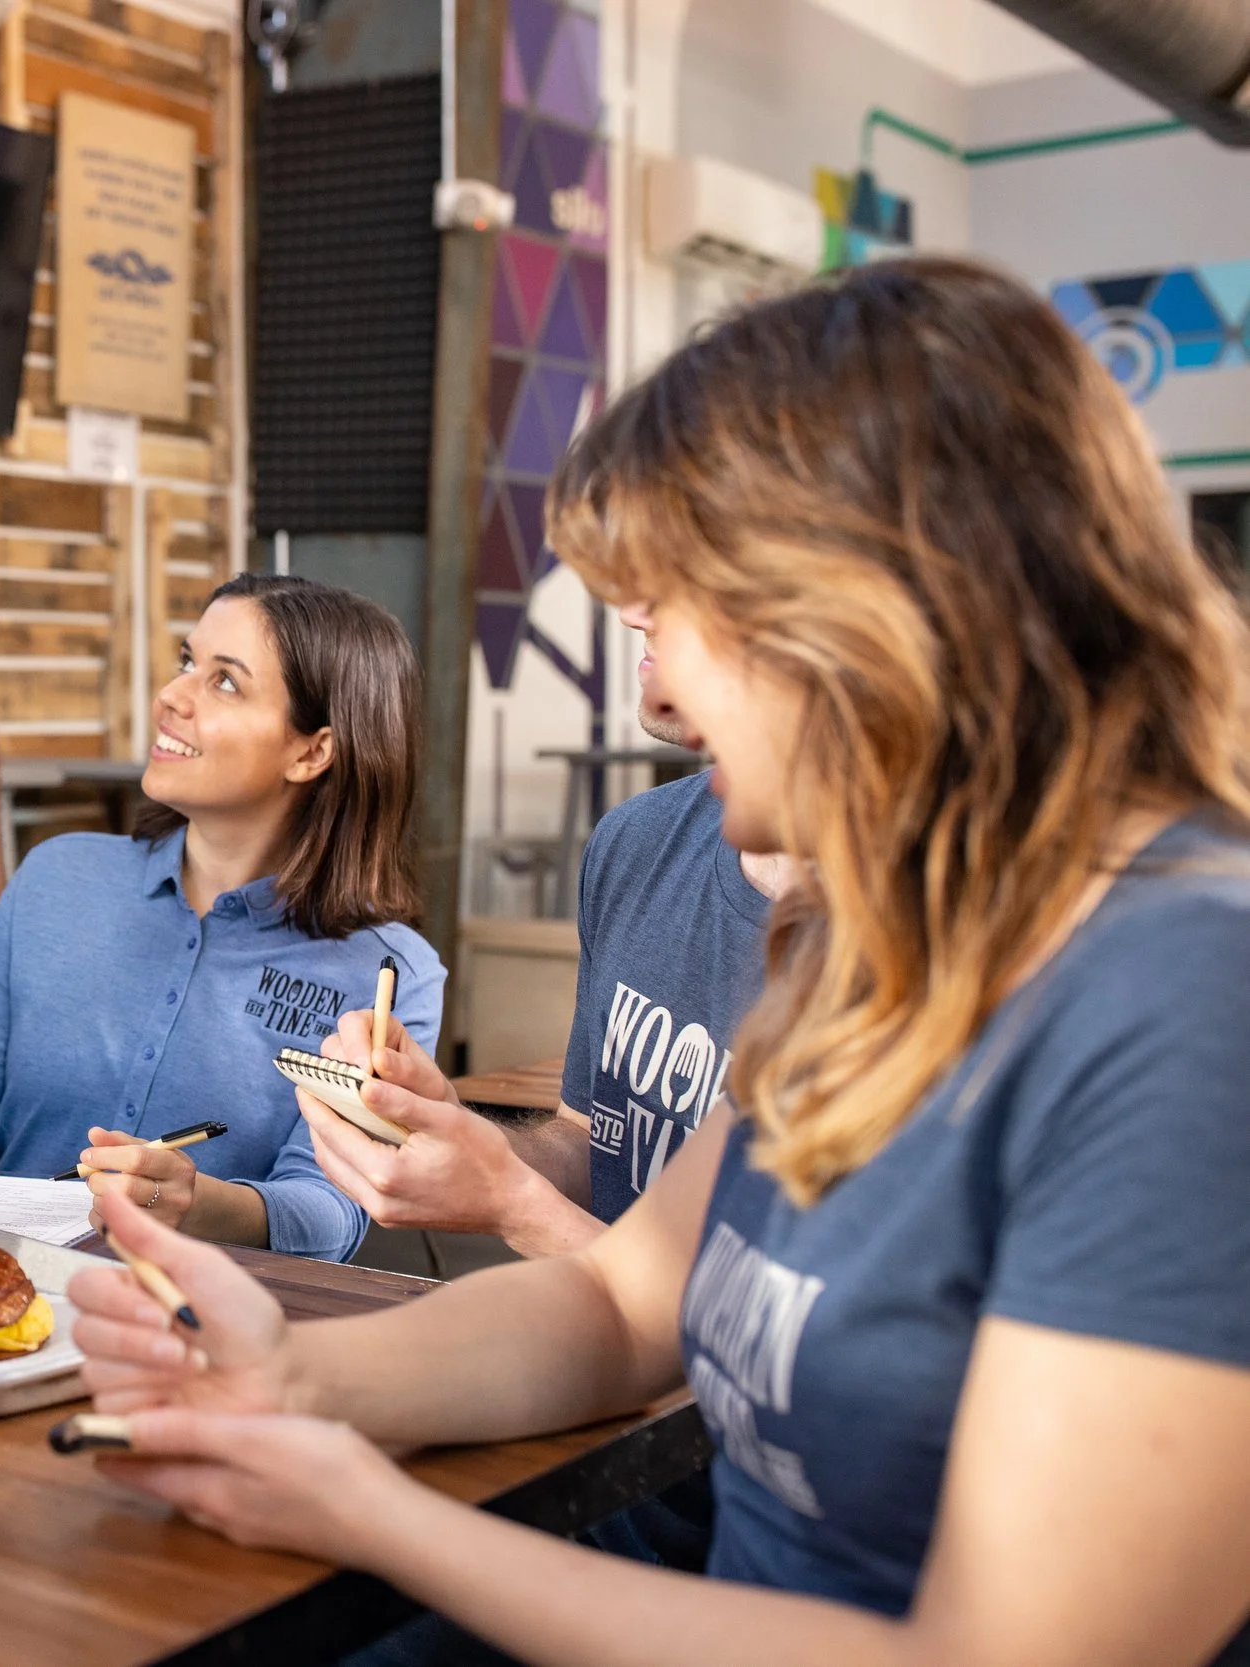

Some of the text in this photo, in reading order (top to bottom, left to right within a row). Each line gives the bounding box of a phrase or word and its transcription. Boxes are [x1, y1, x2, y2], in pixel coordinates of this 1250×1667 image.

[258, 965, 348, 1018] WOODEN
[264, 1000, 317, 1038] TINE
[601, 981, 735, 1130] WOOD
[627, 1097, 696, 1195] TI
